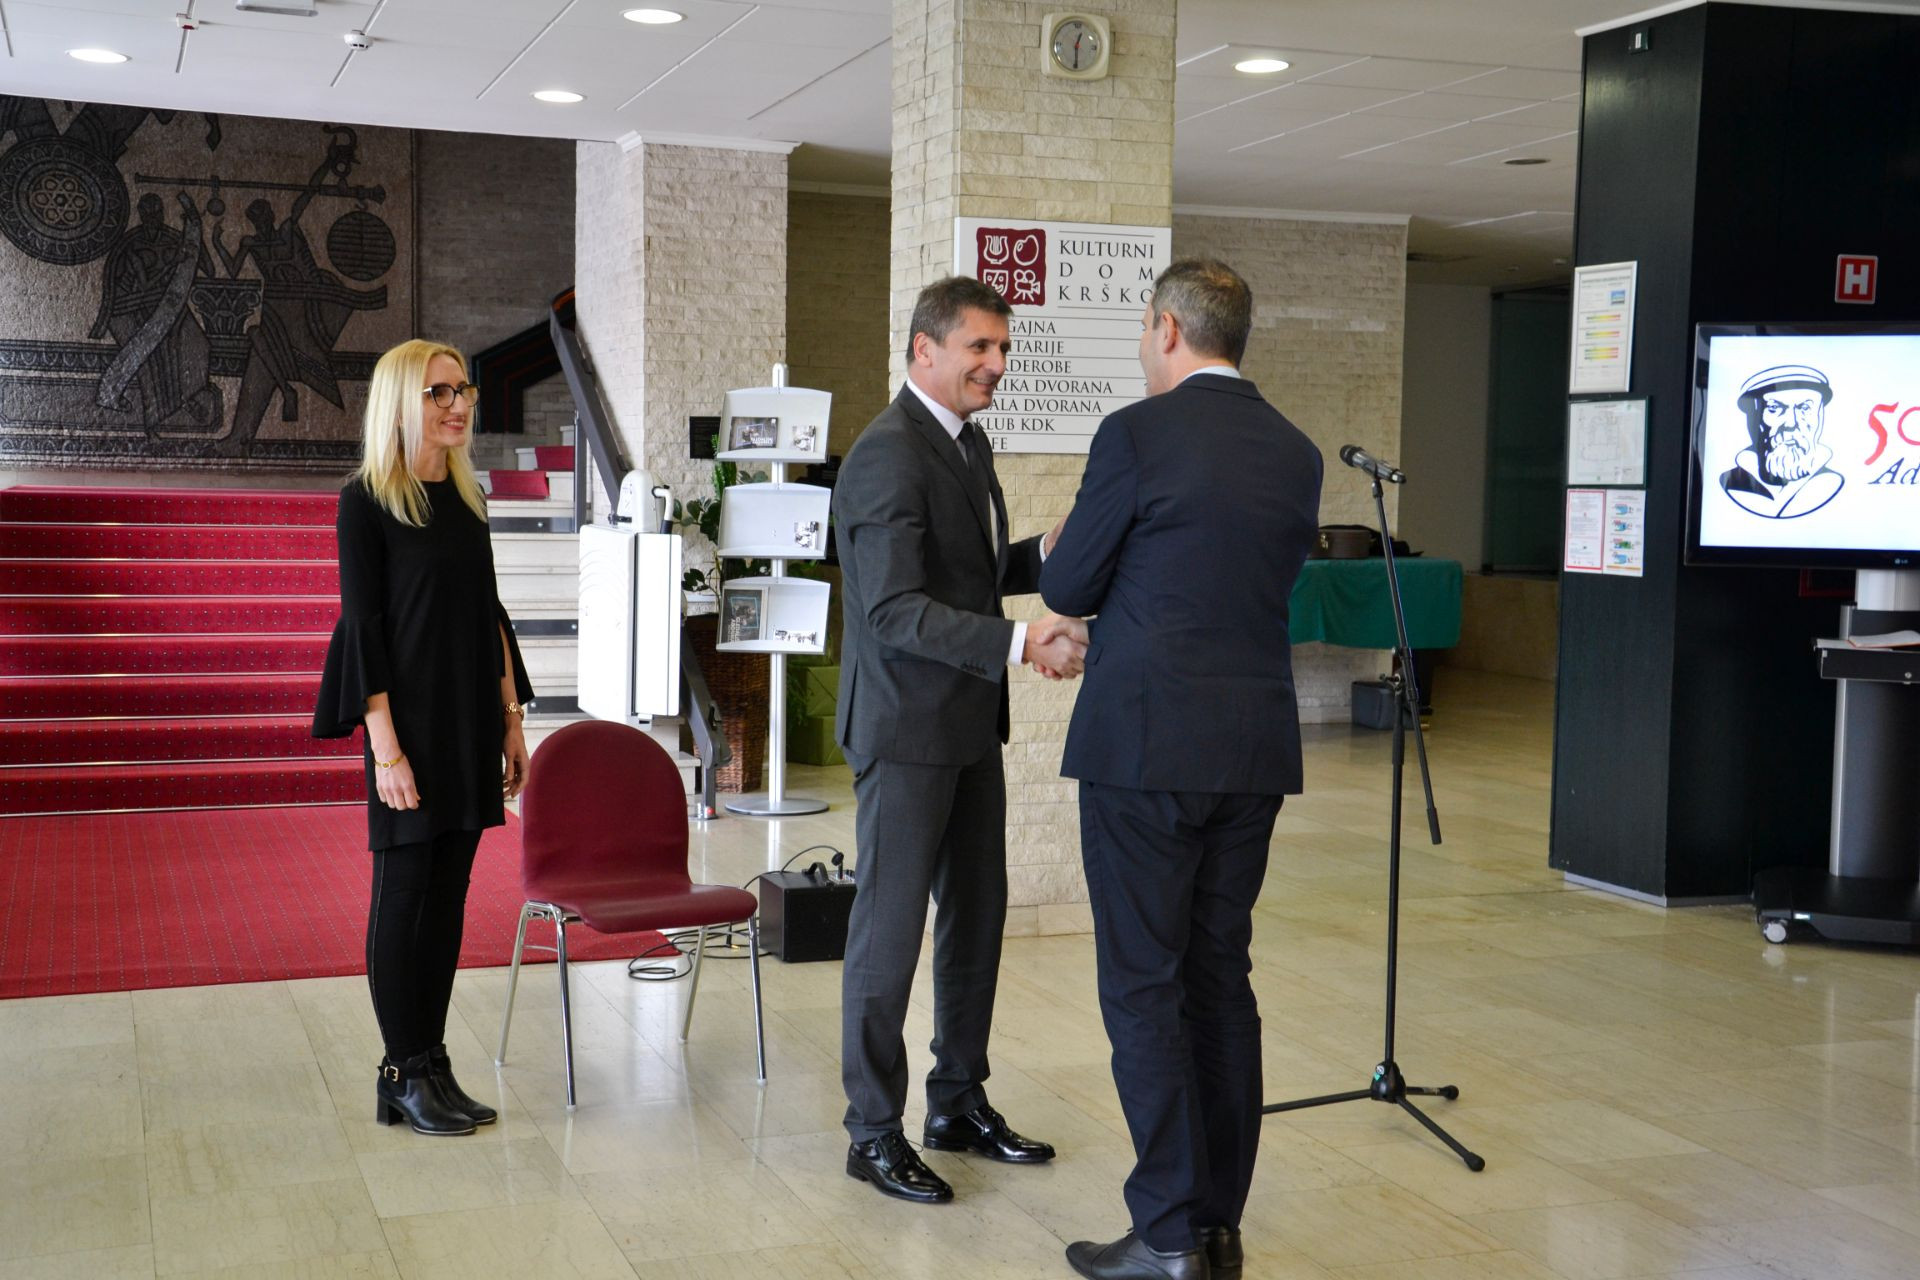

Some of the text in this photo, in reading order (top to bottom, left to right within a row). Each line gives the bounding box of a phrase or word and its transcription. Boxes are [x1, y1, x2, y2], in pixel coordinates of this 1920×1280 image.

[1060, 239, 1154, 259] KULTURNI
[1844, 263, 1869, 295] H
[1010, 339, 1064, 357] TARIJE
[1006, 359, 1072, 374] DEROBE
[1035, 380, 1113, 394] DVORANA
[1024, 399, 1102, 413] DVORANA
[1021, 418, 1055, 431] KDK
